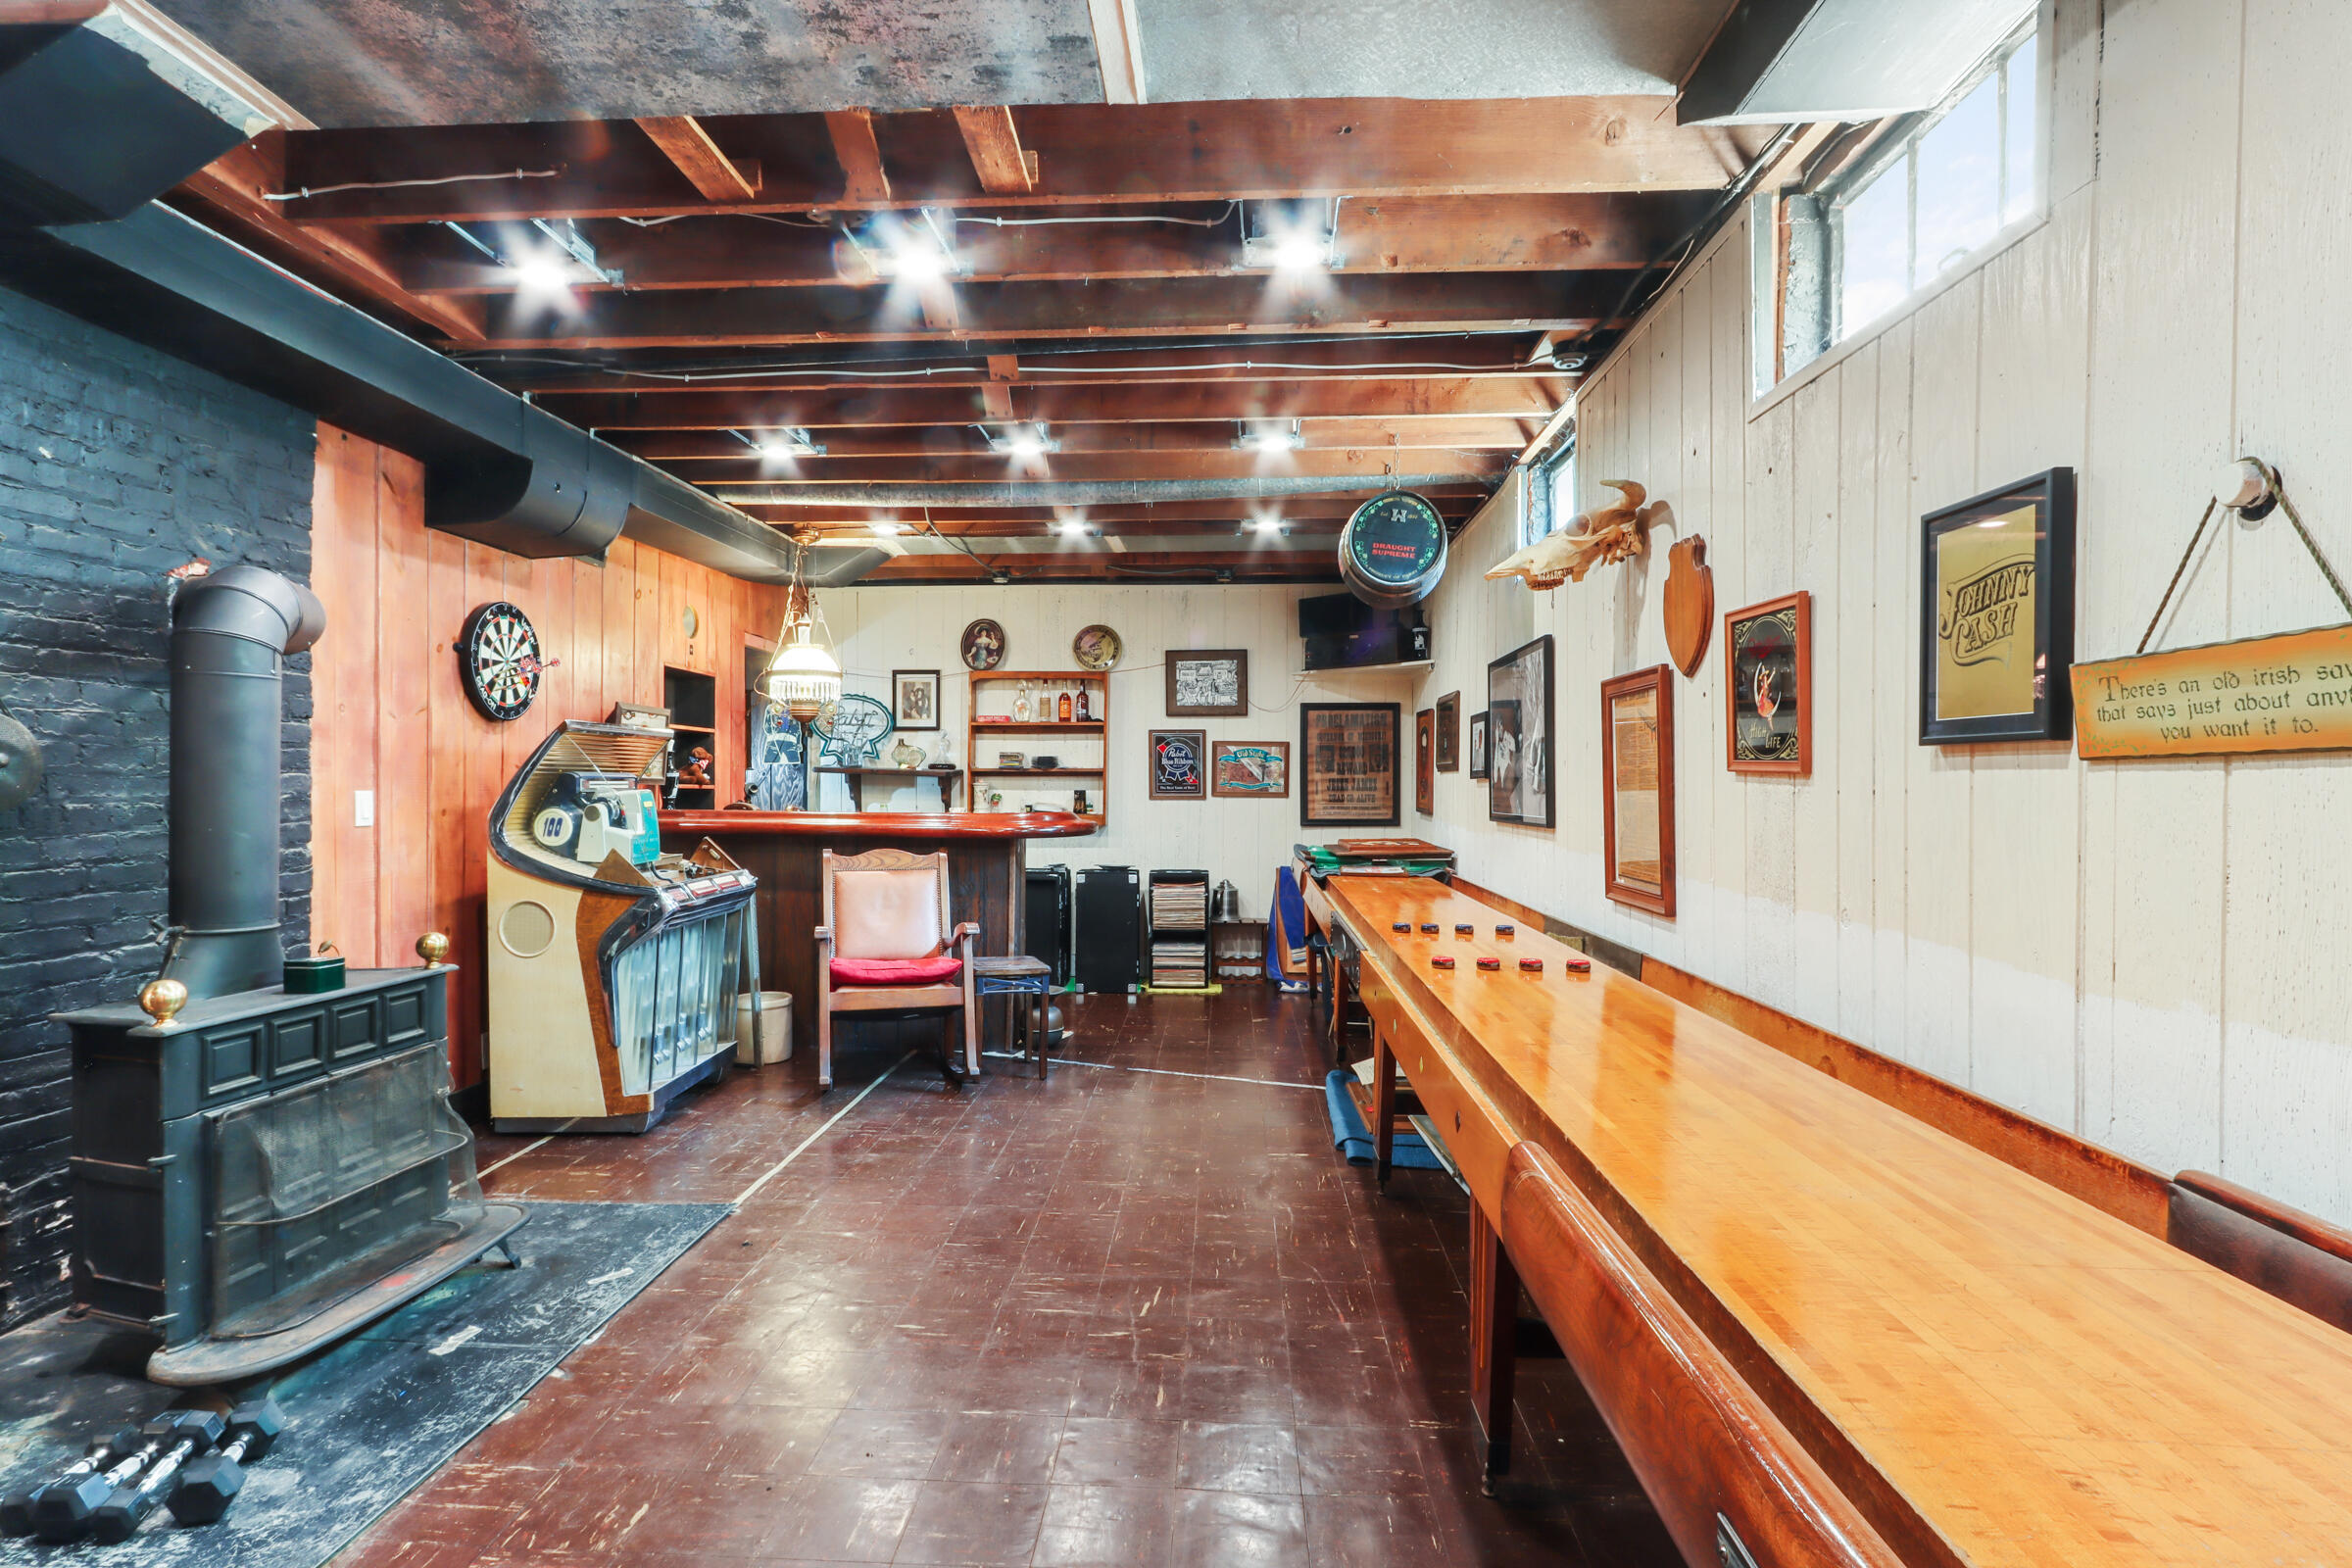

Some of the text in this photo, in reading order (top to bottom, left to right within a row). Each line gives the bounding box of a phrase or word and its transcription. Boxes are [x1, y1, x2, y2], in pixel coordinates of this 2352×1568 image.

[1372, 542, 1416, 552] DRAUGHT
[1372, 549, 1416, 559] SUPREME
[1938, 565, 2034, 640] JOHNNY
[1950, 601, 2018, 664] CASH
[2098, 676, 2167, 702] There's
[2179, 679, 2200, 694] an
[2213, 670, 2240, 690] old
[2253, 664, 2300, 686] irish
[2097, 706, 2126, 722] that
[2136, 704, 2177, 721] says
[2187, 697, 2221, 720] just
[2234, 690, 2290, 711] about
[1765, 731, 1781, 749] LIFE
[2160, 716, 2319, 744] you want it to.
[1168, 747, 1186, 757] Pabst
